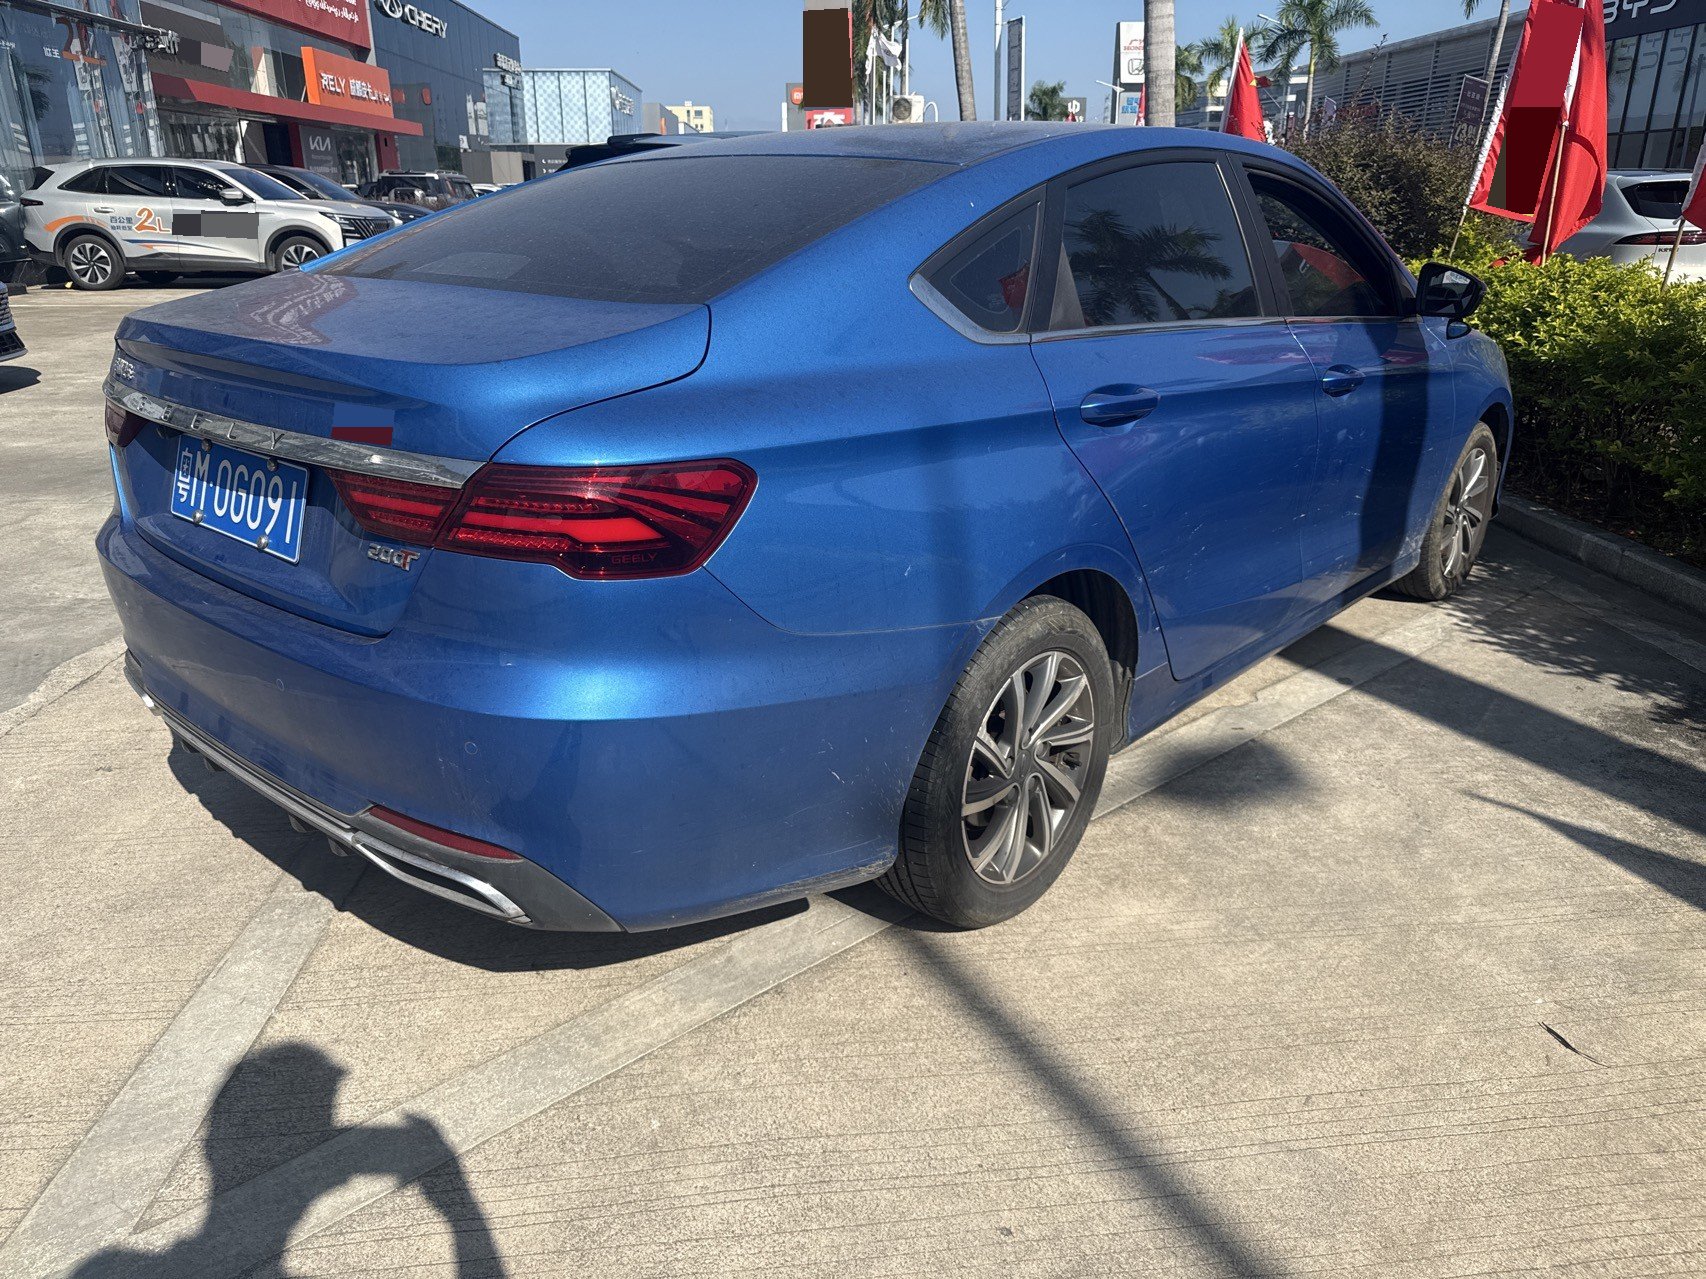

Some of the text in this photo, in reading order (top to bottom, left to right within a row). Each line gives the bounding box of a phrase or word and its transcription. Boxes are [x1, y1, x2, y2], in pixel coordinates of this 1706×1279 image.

[404, 4, 448, 38] CHERY
[320, 72, 346, 95] RELY
[110, 215, 133, 224] 百公里
[136, 395, 286, 450] GEELY
[367, 543, 420, 571] 200T
[611, 552, 657, 565] GEELY
